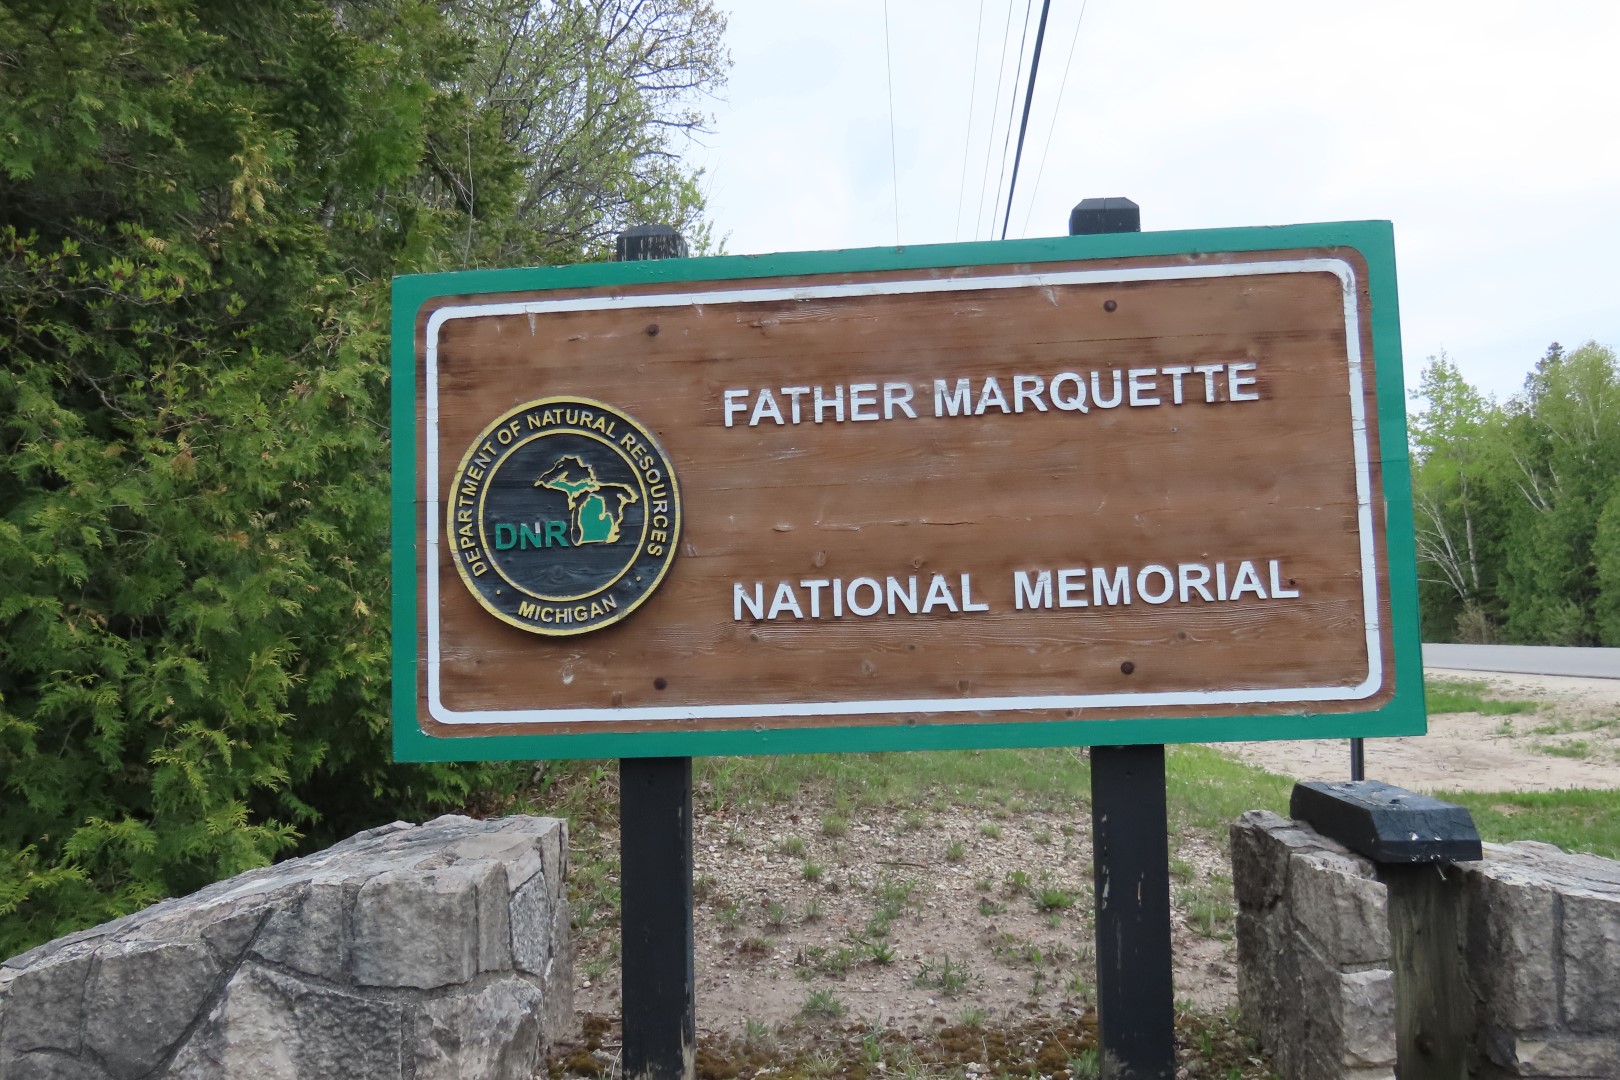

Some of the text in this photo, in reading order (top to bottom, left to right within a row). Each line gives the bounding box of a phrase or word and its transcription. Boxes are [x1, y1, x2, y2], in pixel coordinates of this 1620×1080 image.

[723, 362, 1259, 427] FATHER MARQUETTE
[457, 408, 669, 577] DEPARTMENT OF NATURAL RESOURCES
[495, 520, 570, 550] DNR
[518, 594, 618, 624] MICHIGAN
[732, 559, 1300, 621] NATIONAL MEMORIAL
